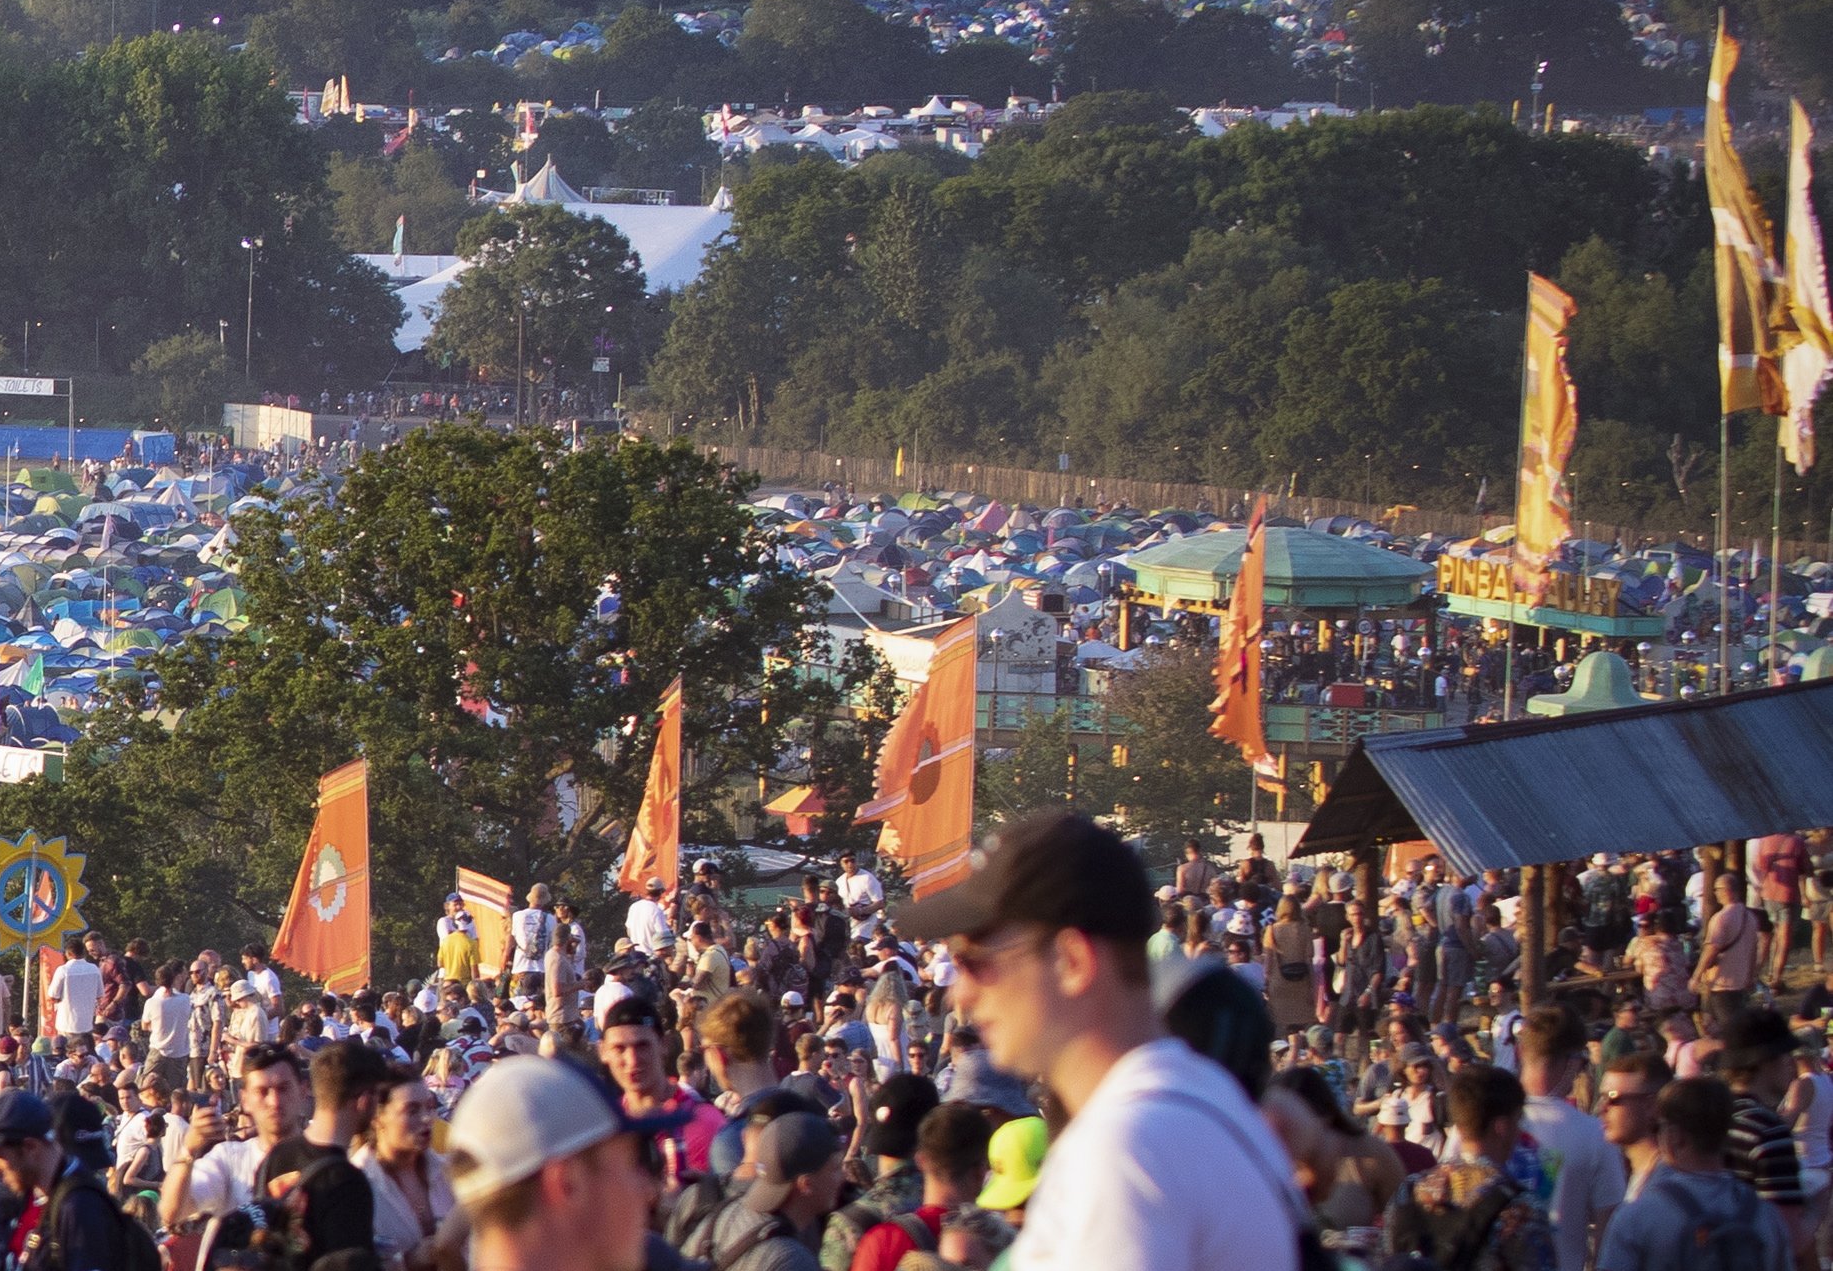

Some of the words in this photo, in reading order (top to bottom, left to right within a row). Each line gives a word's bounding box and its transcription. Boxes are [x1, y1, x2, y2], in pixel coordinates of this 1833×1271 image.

[4, 379, 43, 393] TOILETS
[1437, 554, 1544, 604] PINBA
[1545, 570, 1623, 617] ALLEY
